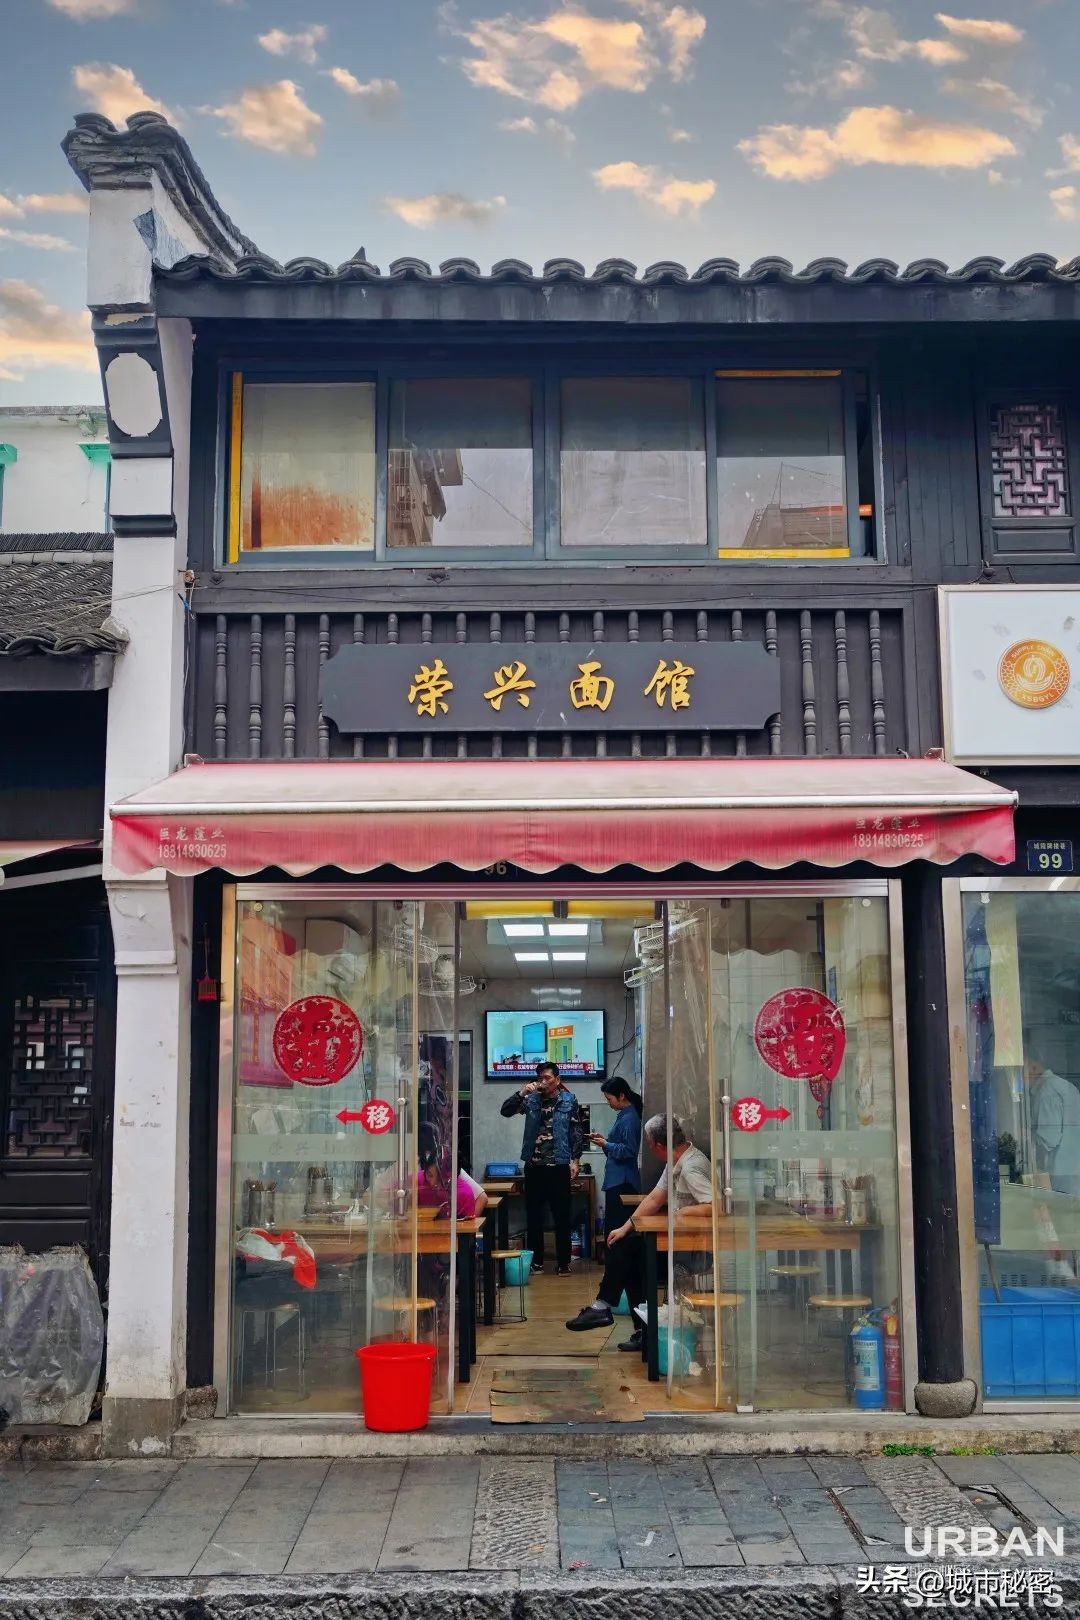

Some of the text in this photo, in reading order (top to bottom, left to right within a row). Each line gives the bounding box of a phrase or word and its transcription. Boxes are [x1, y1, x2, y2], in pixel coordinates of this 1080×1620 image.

[407, 659, 696, 718] 荣兴面馆
[1038, 853, 1063, 869] 99
[366, 1105, 390, 1129] 移
[738, 1102, 762, 1128] 移
